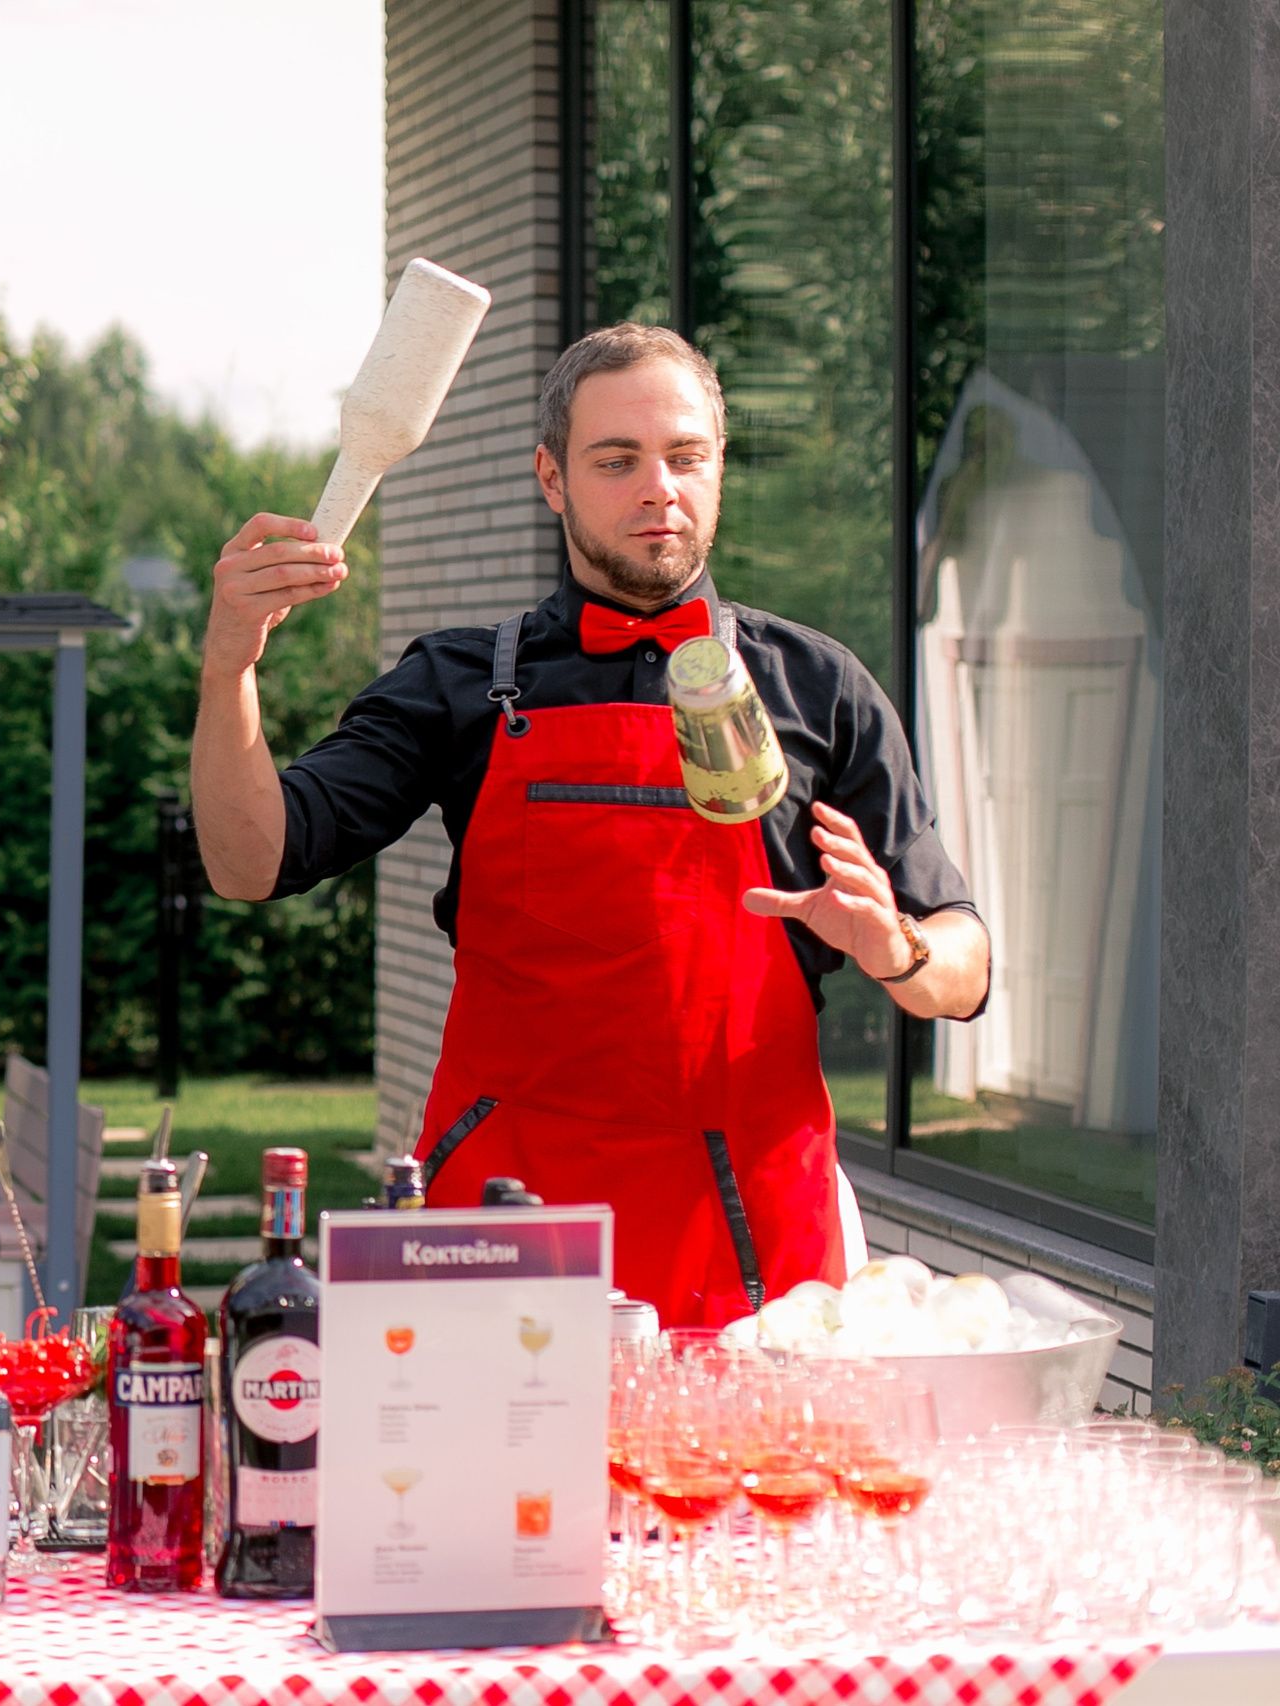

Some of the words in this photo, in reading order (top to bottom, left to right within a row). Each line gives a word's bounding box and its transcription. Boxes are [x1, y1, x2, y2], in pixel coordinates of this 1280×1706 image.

[402, 1238, 519, 1265] Коктейли
[117, 1373, 204, 1402] CAMPAR
[243, 1379, 318, 1400] MARTIN
[261, 1474, 309, 1484] ROSSO
